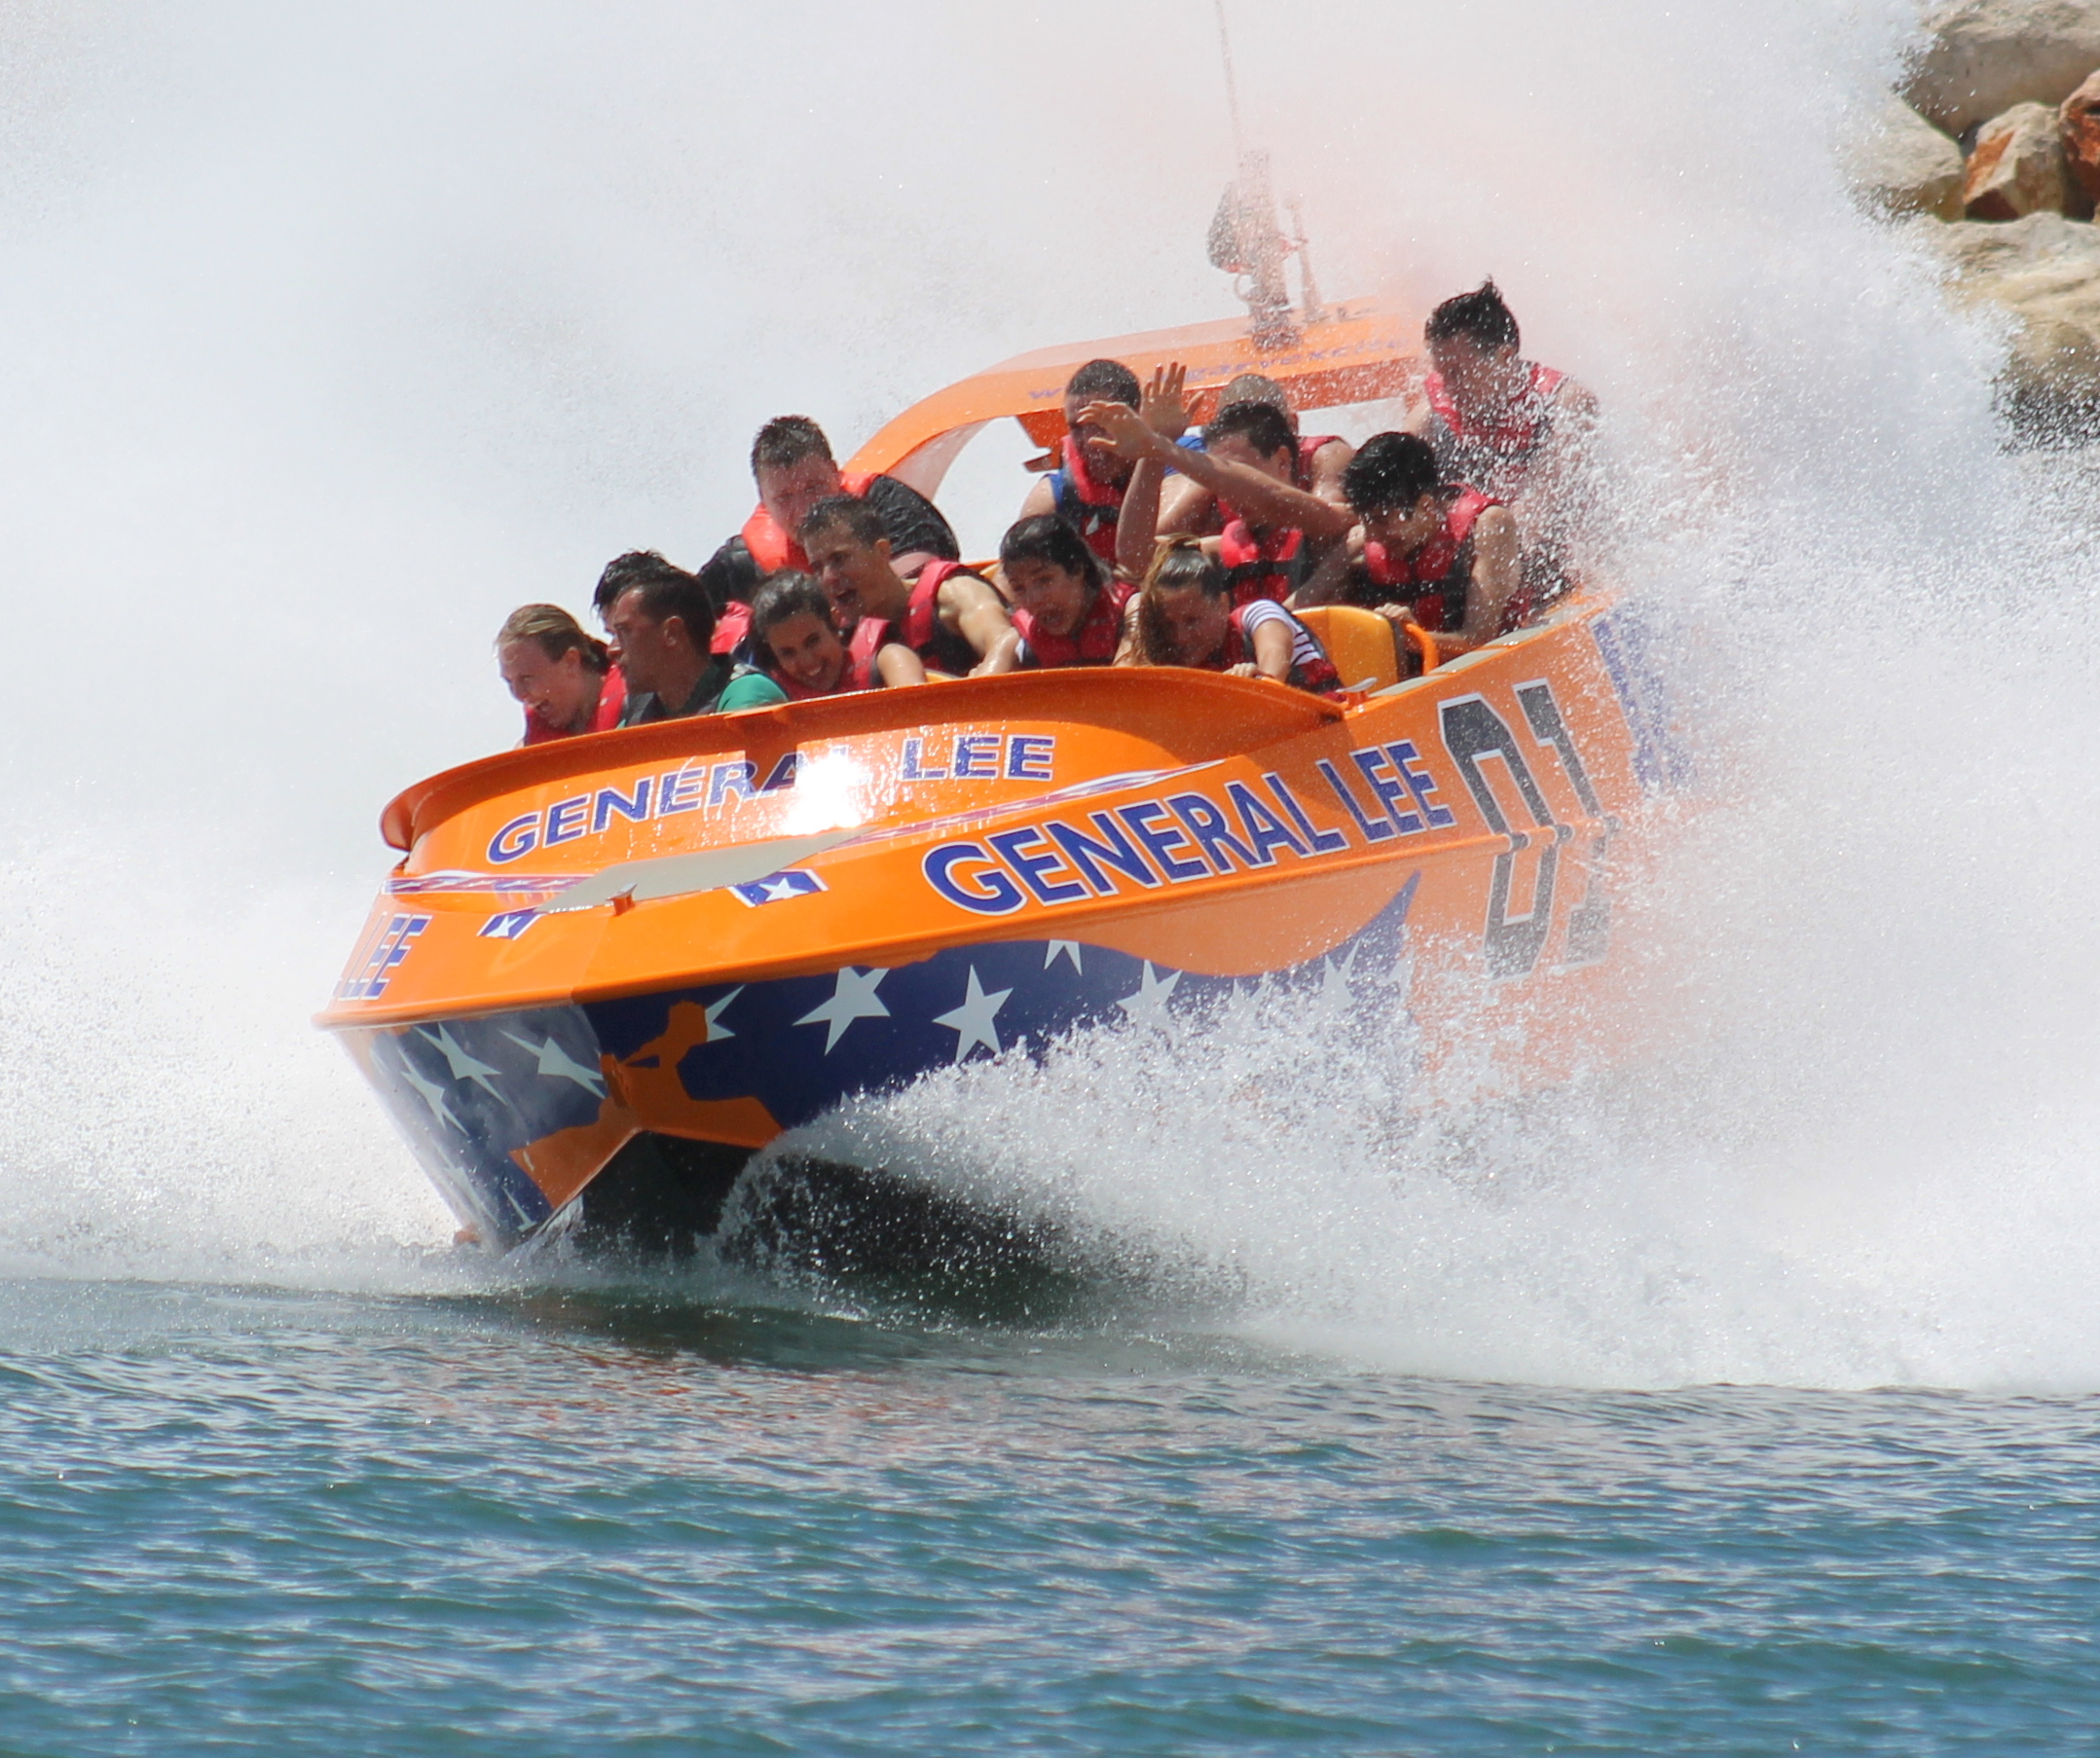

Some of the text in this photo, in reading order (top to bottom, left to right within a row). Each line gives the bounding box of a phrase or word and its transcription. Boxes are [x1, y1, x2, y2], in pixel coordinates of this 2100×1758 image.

[486, 734, 1056, 864] GENERA LEE
[921, 738, 1457, 917] GENERAL LEE
[336, 911, 433, 1002] LEE
